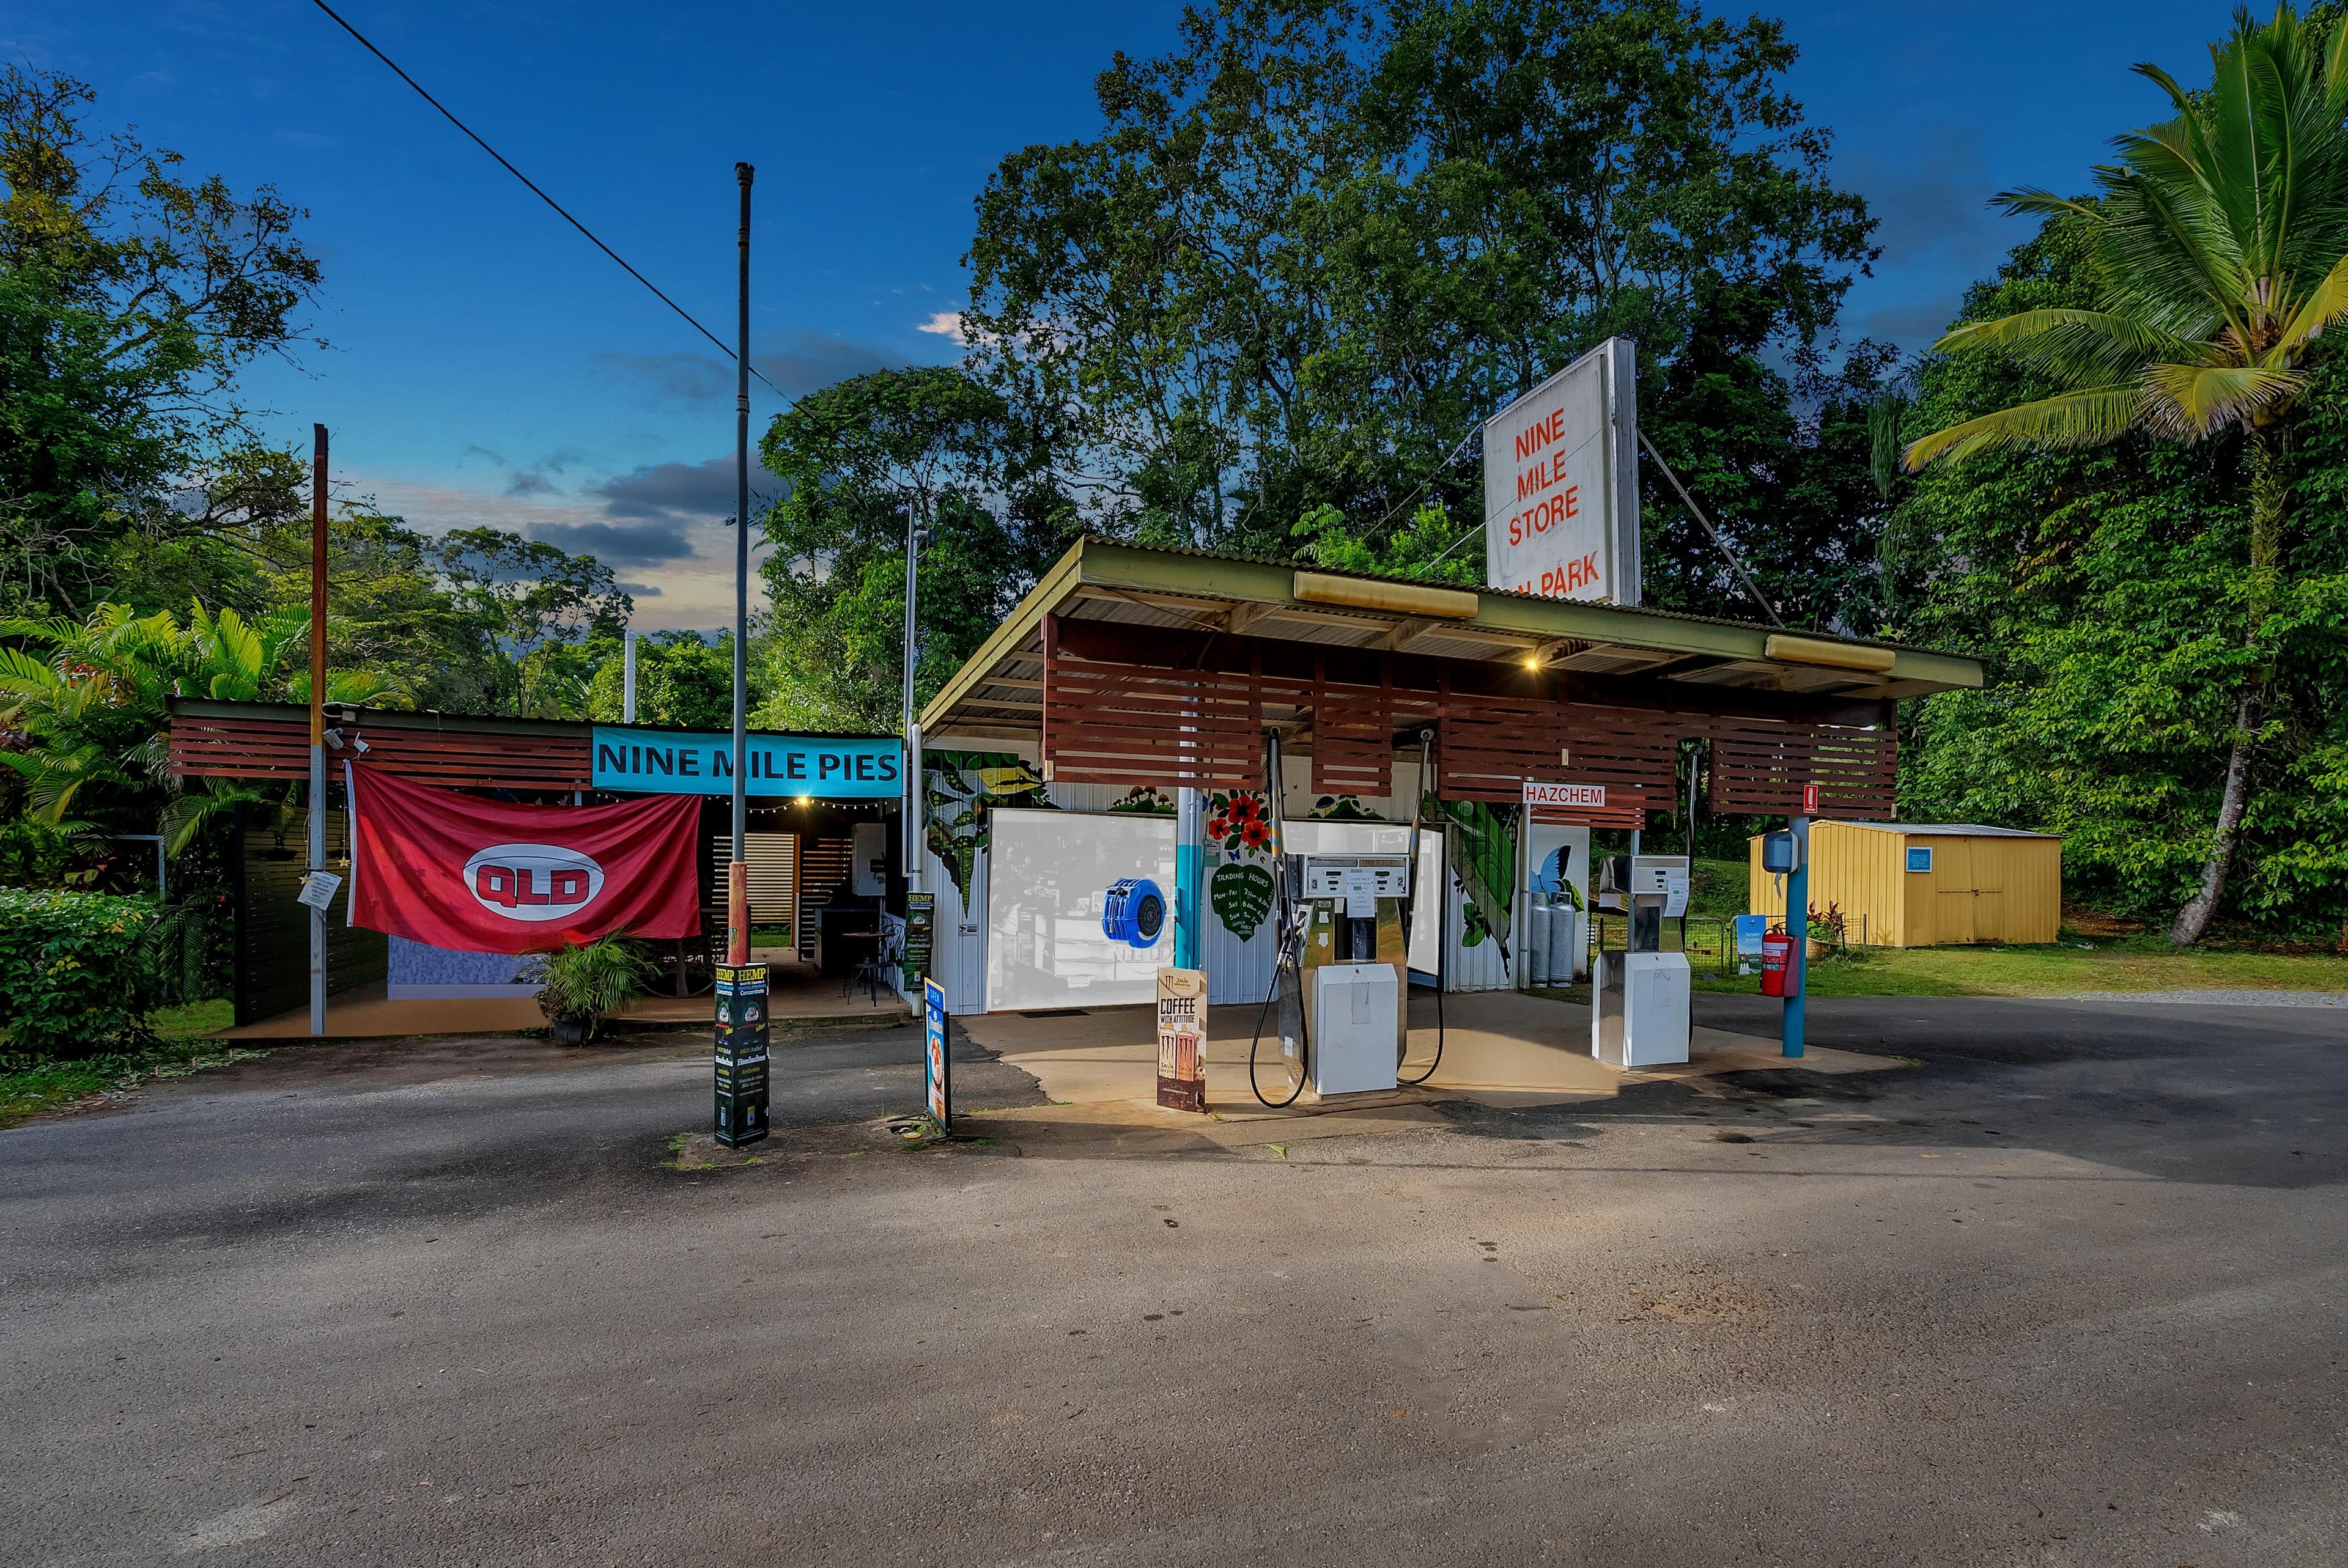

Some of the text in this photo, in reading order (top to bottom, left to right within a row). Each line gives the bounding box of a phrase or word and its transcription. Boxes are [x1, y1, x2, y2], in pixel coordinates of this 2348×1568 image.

[1516, 407, 1565, 463] NINE
[1517, 449, 1567, 503] MILE
[1509, 485, 1579, 547] STORE
[1541, 550, 1600, 597] PARK
[599, 743, 700, 776] NINE
[818, 754, 898, 781] PIES
[1526, 786, 1602, 803] HAZCHEM
[476, 864, 590, 908] QLD
[1216, 872, 1269, 887] TRADING HOURS
[1312, 880, 1318, 889] 3
[1397, 877, 1403, 886] 2
[716, 968, 734, 981] HEMP
[737, 968, 766, 982] HEMP
[930, 989, 940, 1003] OPEN
[1161, 998, 1195, 1014] COFFEE
